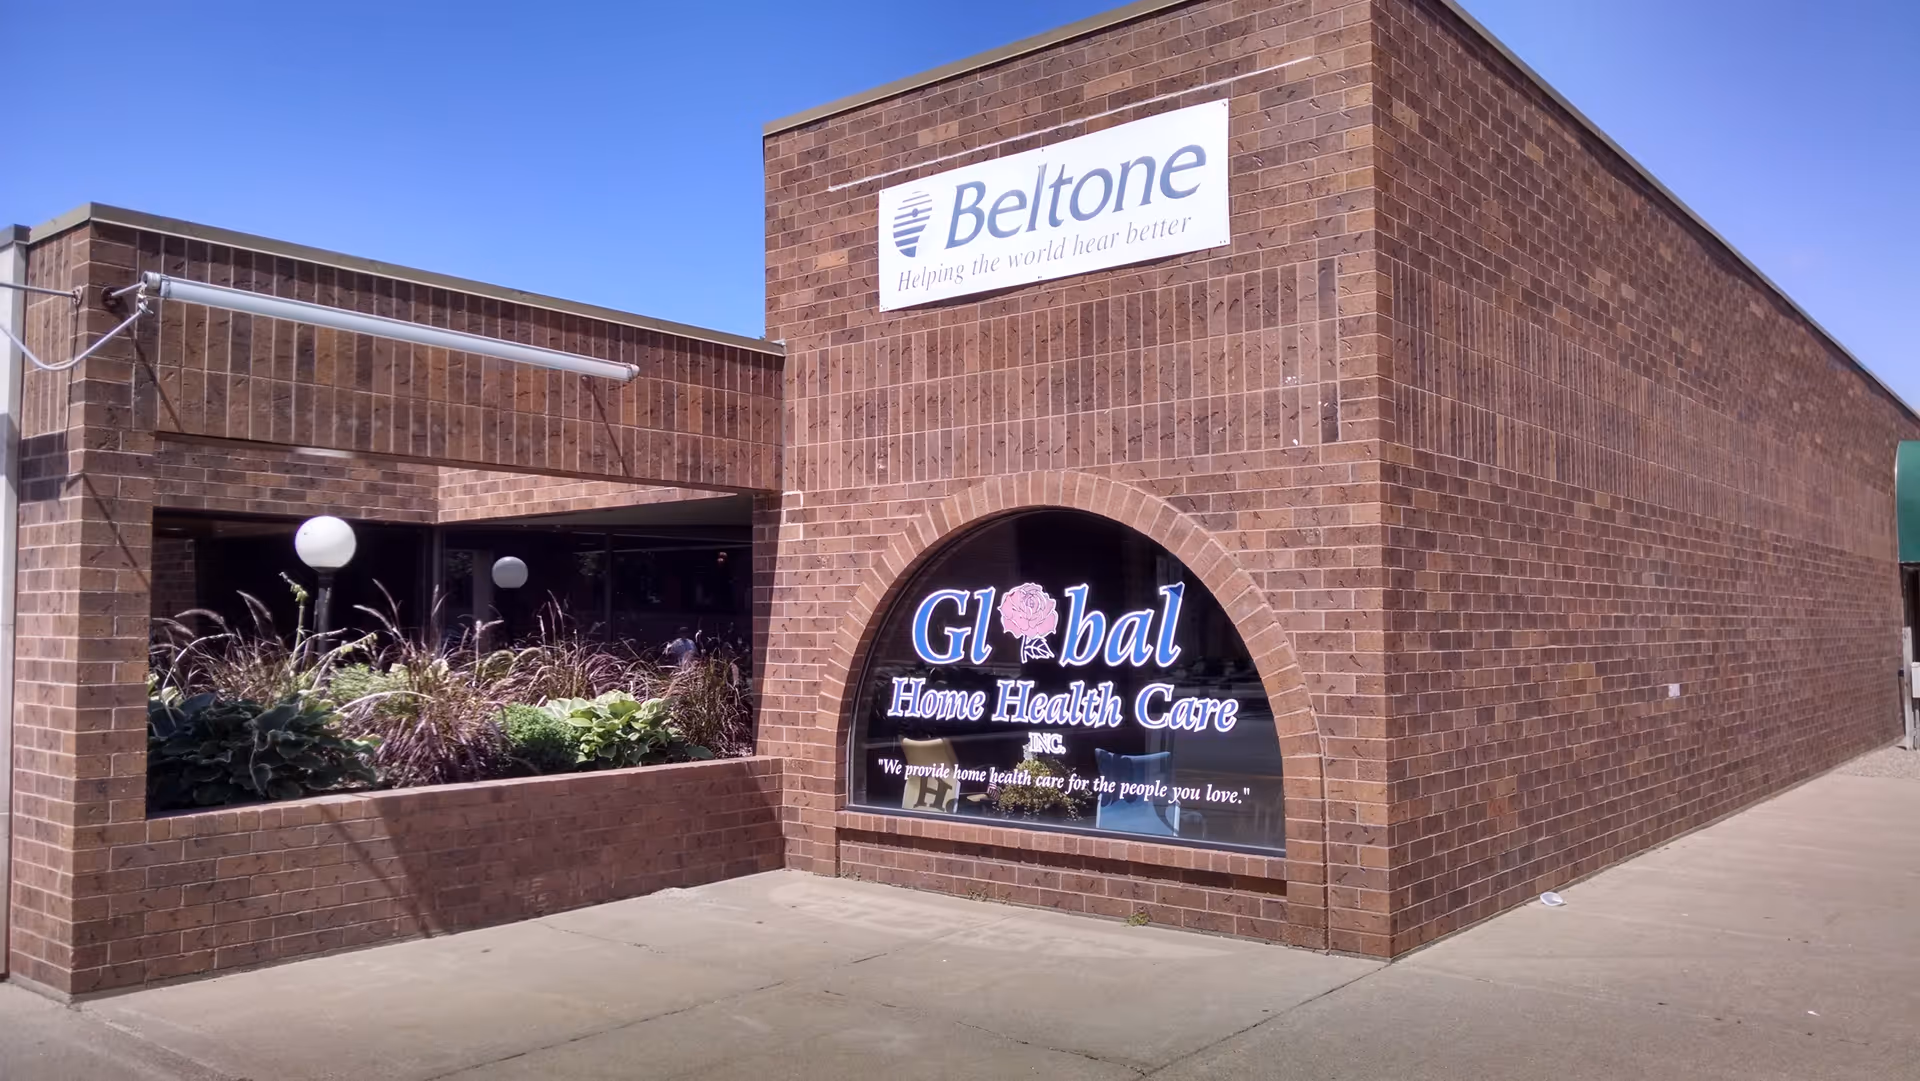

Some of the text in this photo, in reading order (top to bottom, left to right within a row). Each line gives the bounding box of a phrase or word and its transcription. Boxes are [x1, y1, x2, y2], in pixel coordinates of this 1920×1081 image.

[945, 144, 1206, 250] Beltone
[897, 215, 1192, 292] Helping the world hear better
[911, 581, 1185, 668] Glbal
[887, 676, 1239, 732] Home Health Care
[1027, 731, 1067, 756] INC.
[904, 763, 950, 780] provide
[952, 764, 986, 783] home
[989, 766, 1032, 786] health
[1035, 774, 1065, 789] care
[1065, 773, 1090, 795] for
[1093, 776, 1117, 794] the
[1119, 780, 1168, 802] people
[1168, 786, 1201, 804] you
